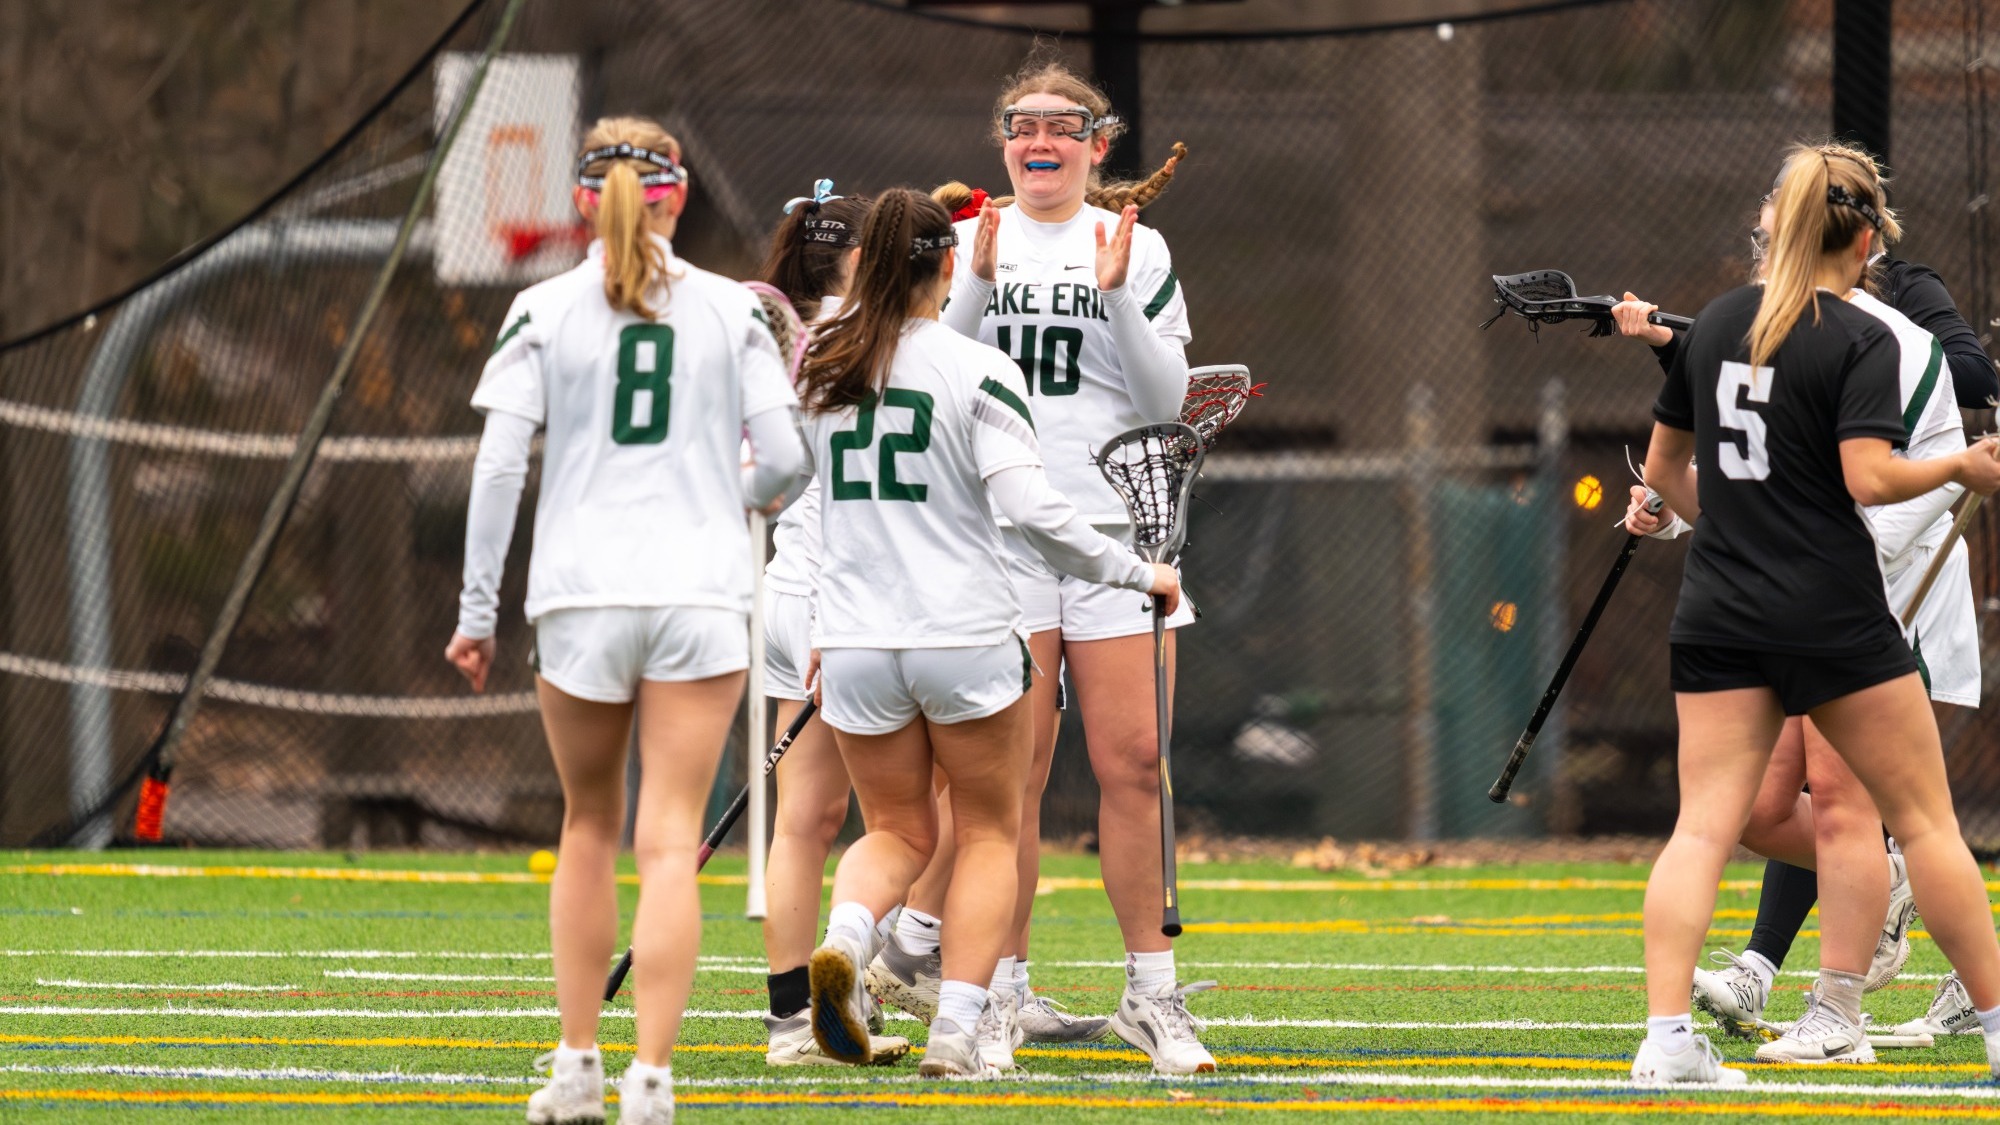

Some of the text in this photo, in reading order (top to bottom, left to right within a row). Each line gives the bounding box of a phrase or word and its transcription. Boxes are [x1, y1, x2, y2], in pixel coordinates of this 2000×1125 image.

[820, 220, 846, 230] STX
[984, 282, 1041, 317] AKE
[612, 324, 674, 445] 8
[997, 325, 1083, 396] 40
[830, 387, 934, 502] 22
[1716, 360, 1775, 481] 5
[762, 731, 793, 775] GAIT
[1941, 1013, 1961, 1027] new
